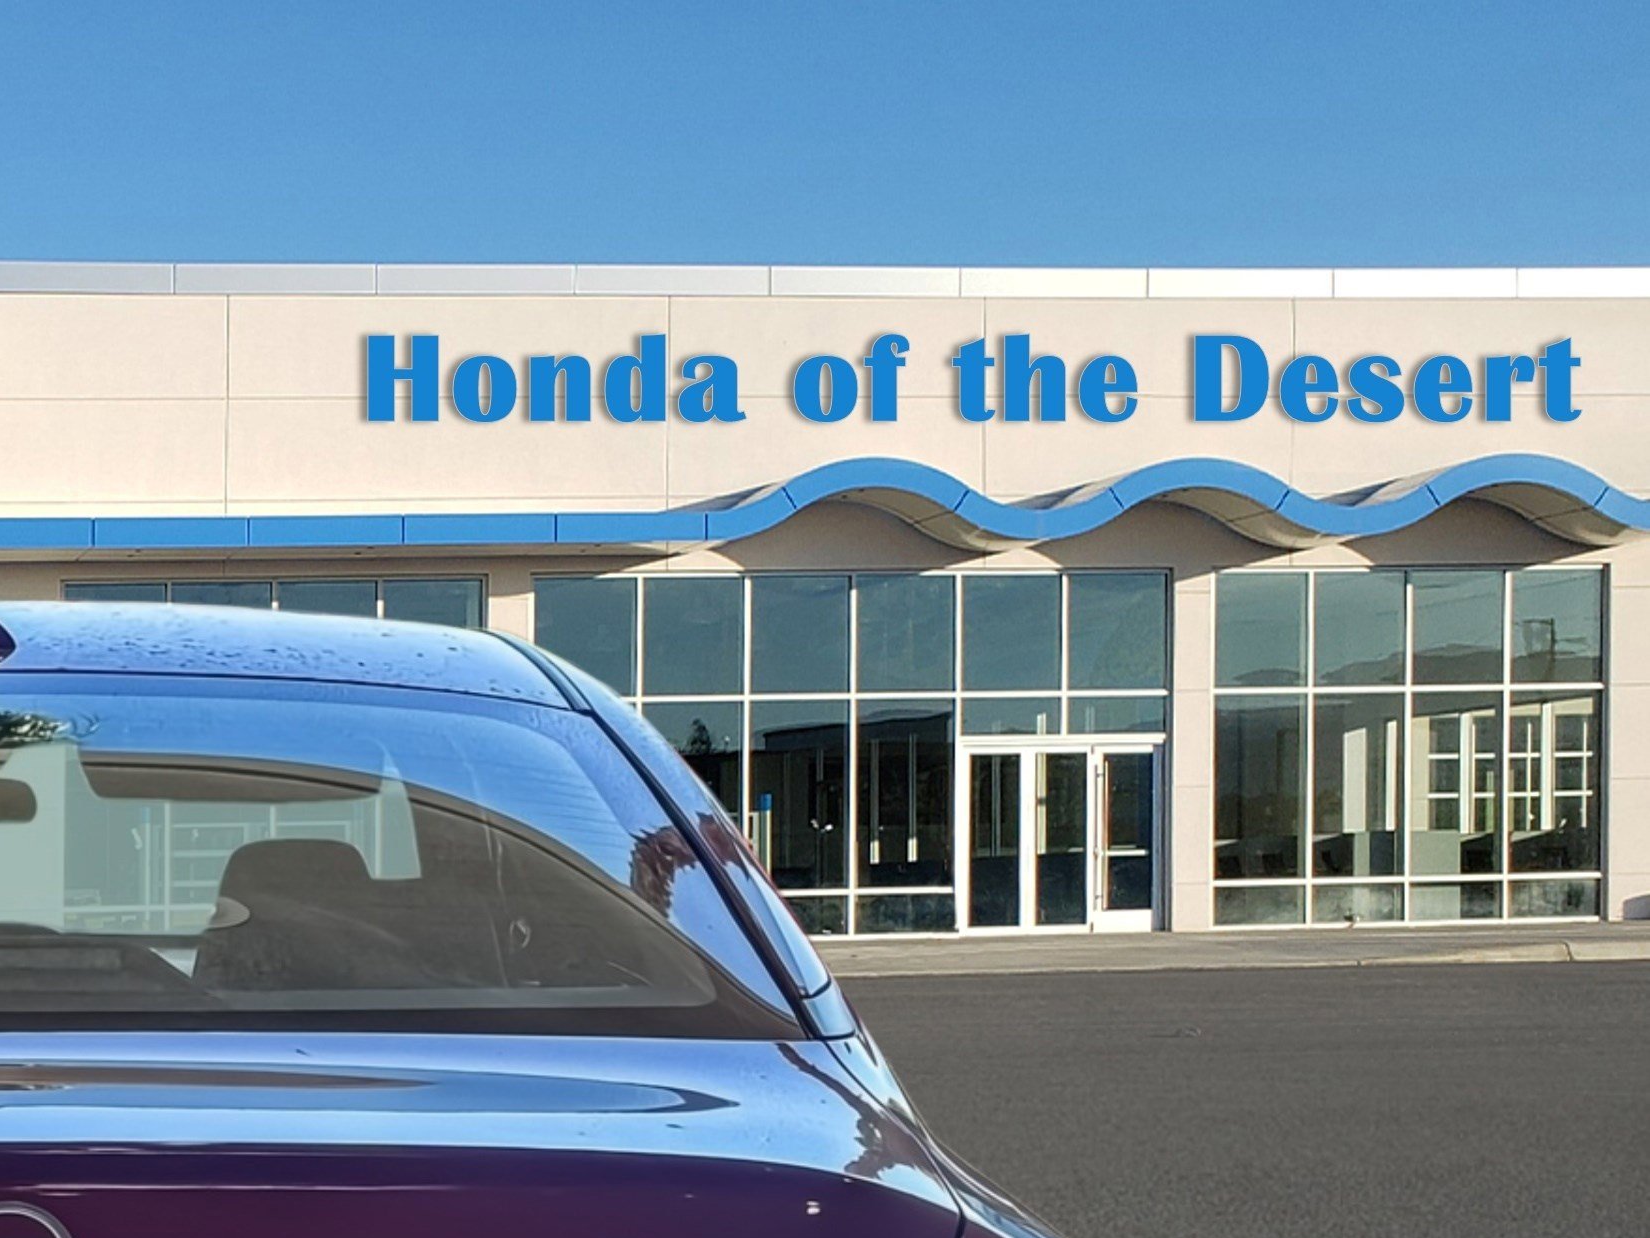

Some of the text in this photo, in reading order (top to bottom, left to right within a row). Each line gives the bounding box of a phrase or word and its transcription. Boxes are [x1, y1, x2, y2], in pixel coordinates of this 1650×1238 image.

[365, 332, 1583, 424] Honda of the Desert
